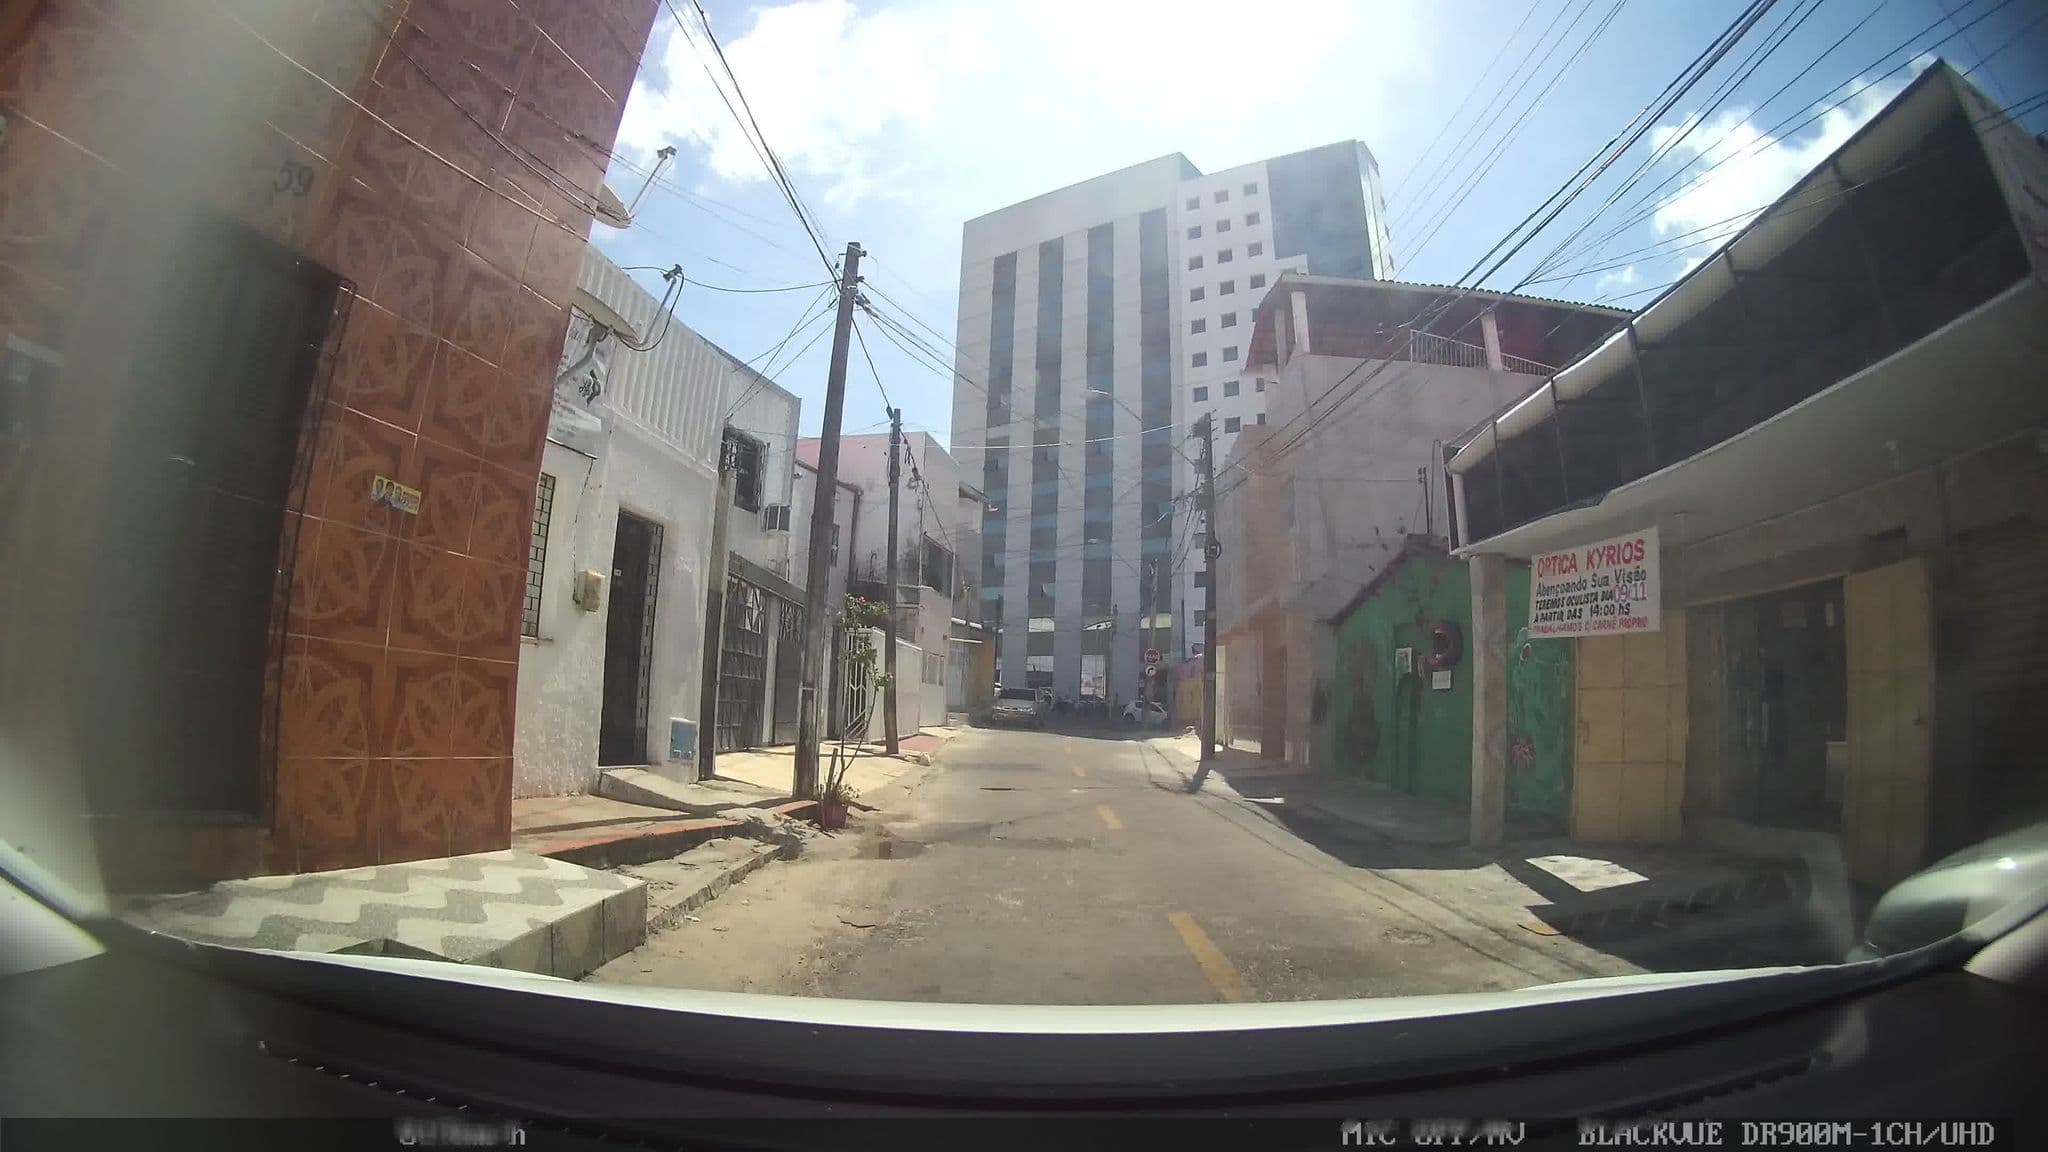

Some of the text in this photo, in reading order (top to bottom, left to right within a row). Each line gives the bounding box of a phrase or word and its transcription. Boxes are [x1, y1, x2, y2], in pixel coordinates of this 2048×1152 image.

[272, 160, 315, 197] 59
[1586, 538, 1645, 570] KYRIOS
[1536, 565, 1647, 597] Abençoando Sua Visão
[1533, 612, 1539, 624] A
[1541, 610, 1564, 624] PARTIR
[1566, 607, 1583, 620] DAS
[1590, 603, 1616, 617] 14:00
[1535, 596, 1565, 611] TEREMOS
[1566, 591, 1598, 607] OCULISTA
[1600, 589, 1613, 602] DIA
